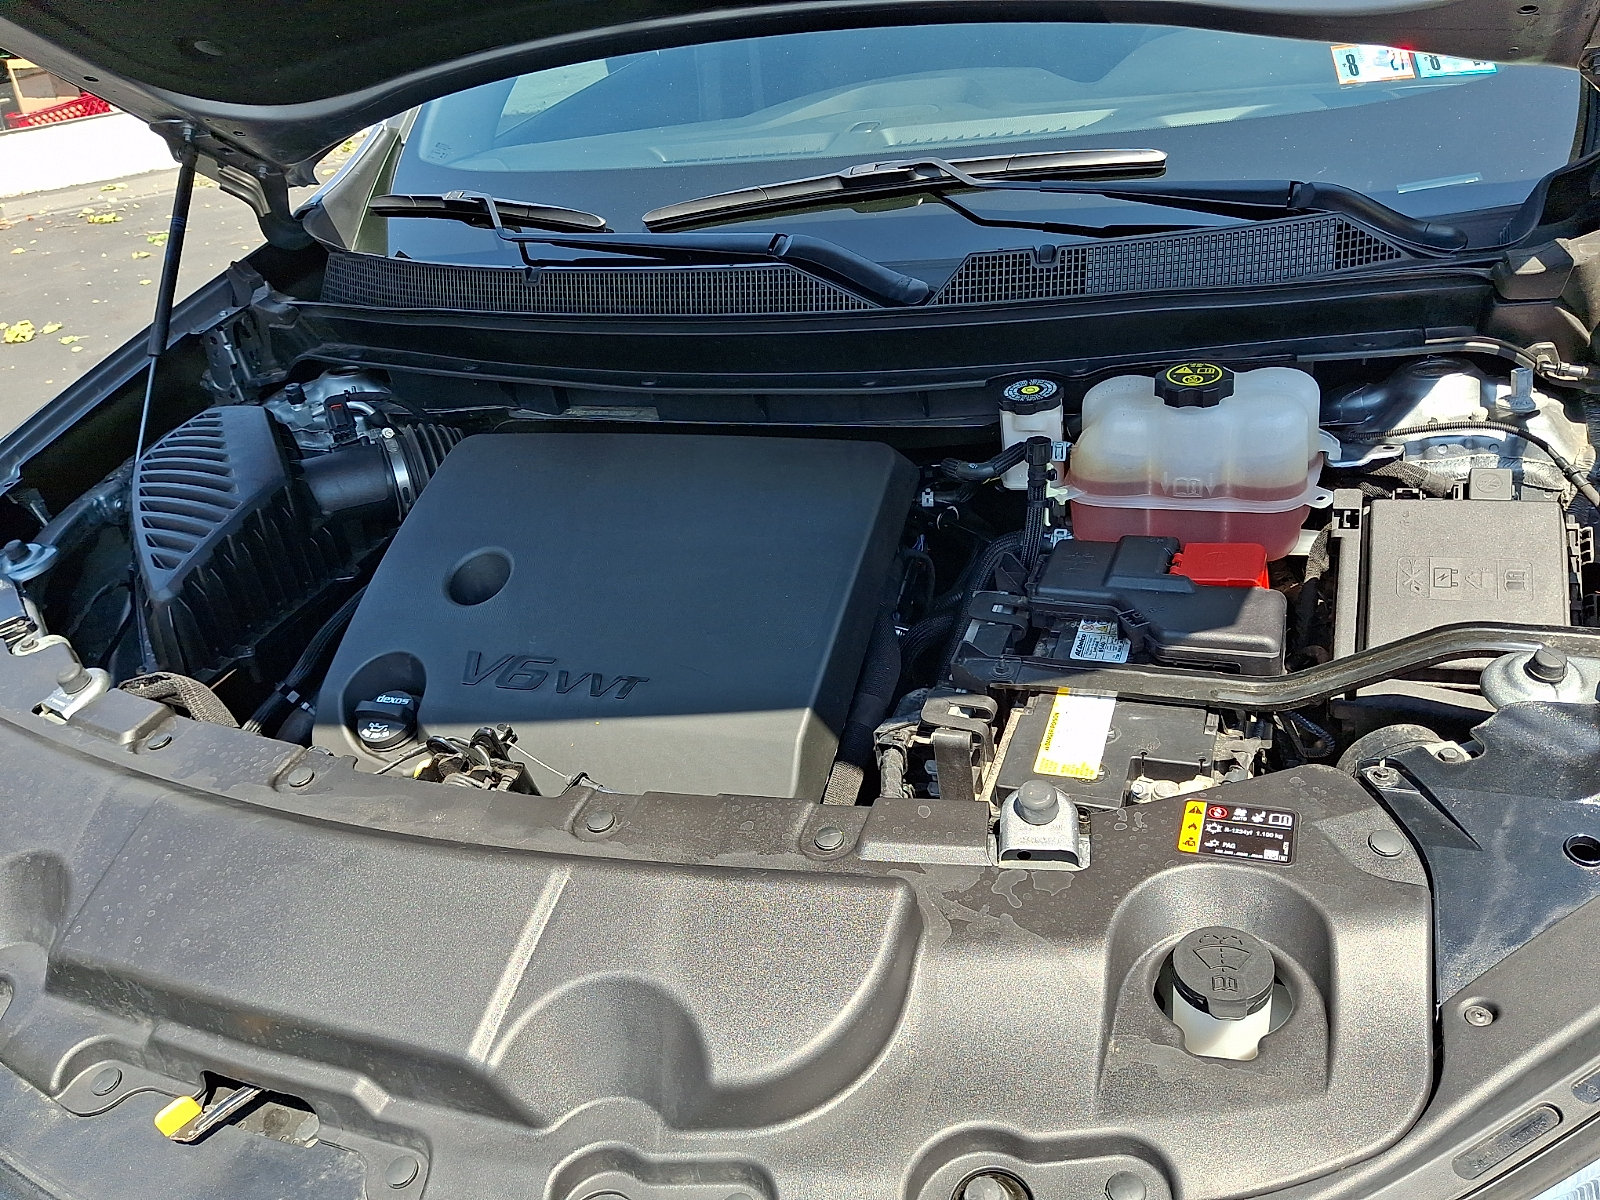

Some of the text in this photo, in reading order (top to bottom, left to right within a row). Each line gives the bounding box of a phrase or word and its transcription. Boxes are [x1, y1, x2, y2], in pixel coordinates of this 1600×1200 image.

[1345, 54, 1360, 77] 8
[460, 650, 650, 700] V6 VVT
[376, 694, 412, 705] dexos
[1222, 841, 1236, 850] PAG
